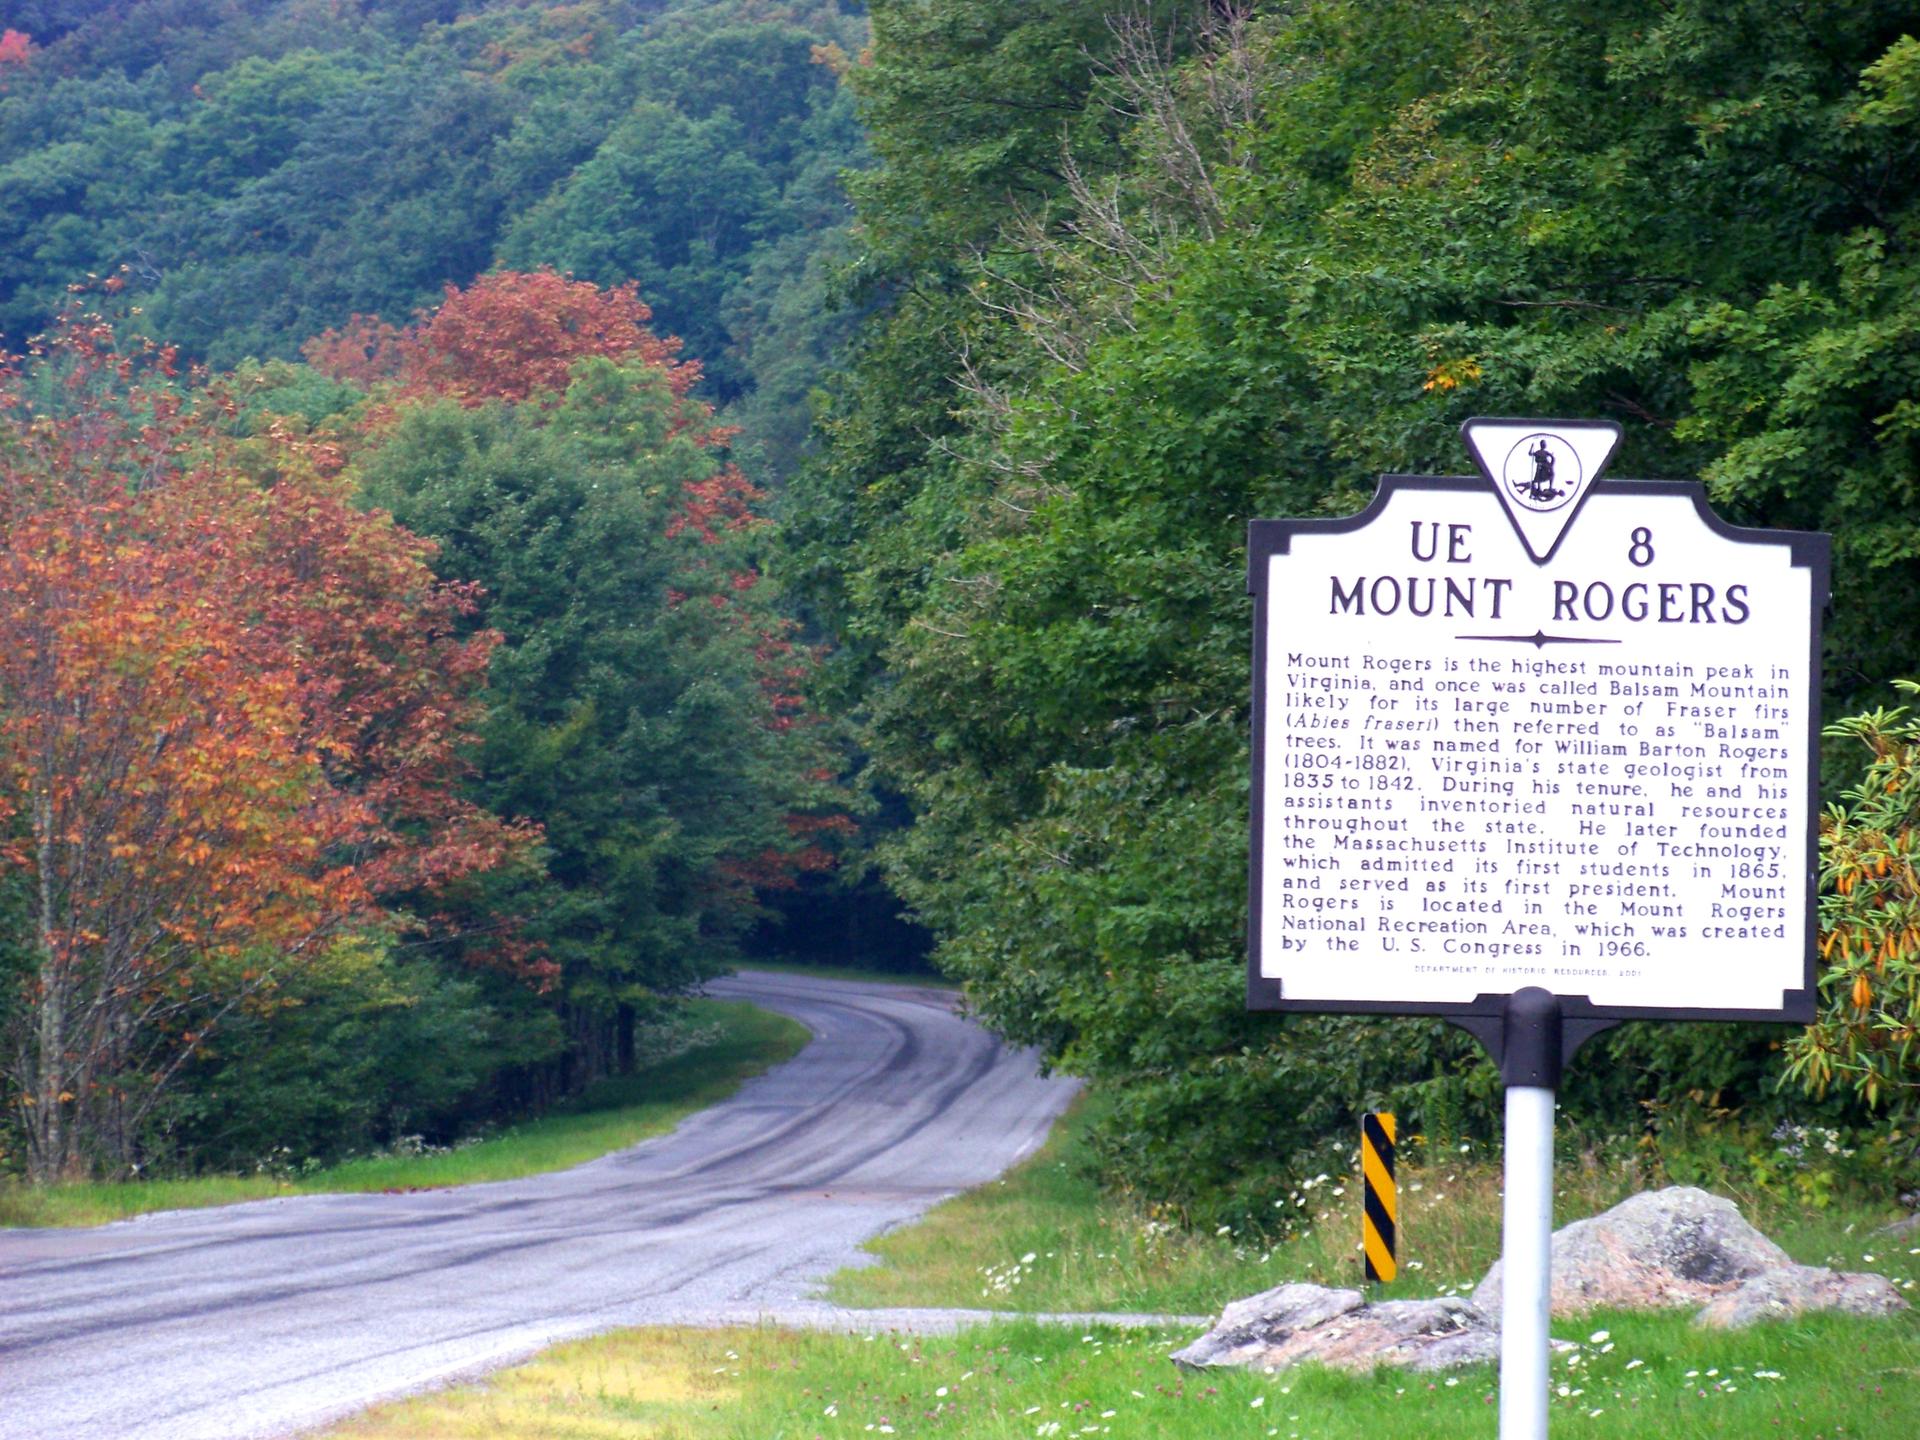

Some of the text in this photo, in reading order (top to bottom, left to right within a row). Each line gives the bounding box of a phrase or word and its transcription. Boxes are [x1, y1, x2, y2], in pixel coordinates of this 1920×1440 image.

[1411, 521, 1654, 567] UE 8
[1330, 576, 1749, 624] MOUNT ROGERS
[1288, 653, 1789, 681] Mount Rogers is the highest mountain peak in
[1287, 673, 1788, 698] Virginia, and once was called Balsam Mountain
[1286, 692, 1788, 719] likely for its large number of Fraser firs
[1286, 713, 1349, 729] (Abies
[1364, 715, 1438, 731] fraseri)
[1454, 718, 1499, 733] then
[1514, 719, 1599, 735] referred
[1619, 723, 1638, 736] to
[1656, 726, 1675, 737] as
[1286, 734, 1788, 762] trees. It was named for William Barton Rogers
[1558, 761, 1609, 775] state
[1624, 762, 1722, 781] geologist
[1741, 763, 1788, 778] from
[1285, 772, 1334, 789] 1835
[1341, 776, 1359, 790] to
[1370, 775, 1421, 791] 1842.
[1443, 776, 1514, 796] During
[1532, 779, 1560, 794] his
[1671, 782, 1693, 797] he
[1707, 785, 1741, 798] and
[1758, 784, 1787, 799] his
[1284, 792, 1787, 819] assistants inventoried natural resources
[1284, 814, 1786, 838] throughout the state. He later founded
[1283, 834, 1315, 849] the
[1334, 834, 1486, 853] Massachusetts
[1507, 838, 1598, 855] Institute
[1618, 841, 1638, 856] of
[1283, 854, 1340, 870] which
[1361, 856, 1453, 872] admitted
[1476, 858, 1498, 873] its
[1517, 859, 1559, 874] first
[1580, 862, 1669, 877] students
[1693, 863, 1711, 878] in
[1283, 876, 1785, 899] and served as its first president. Mount
[1283, 893, 1785, 921] Rogers is located in the Mount Rogers
[1282, 915, 1365, 931] National
[1378, 916, 1487, 933] Recreation
[1575, 922, 1634, 937] which
[1651, 926, 1687, 938] was
[1702, 924, 1784, 938] created
[1282, 935, 1307, 952] by
[1326, 936, 1359, 951] the
[1443, 939, 1542, 958] Congress
[1563, 940, 1580, 956] in
[1599, 941, 1650, 957] 1966.
